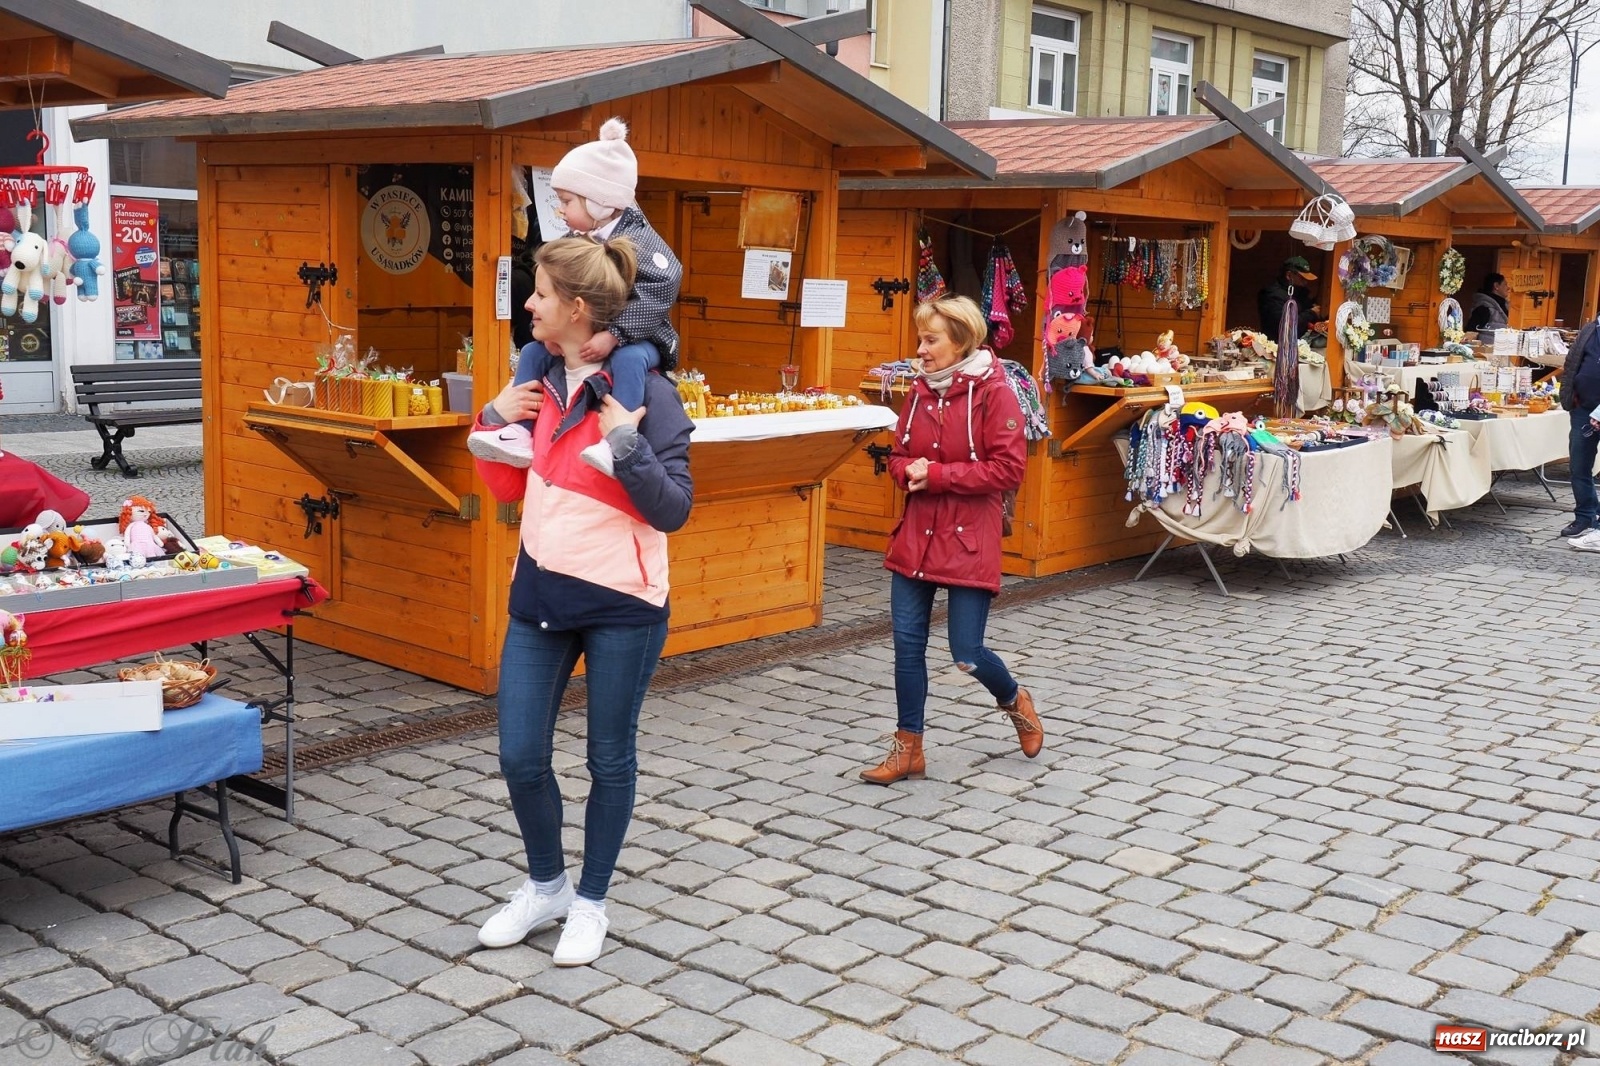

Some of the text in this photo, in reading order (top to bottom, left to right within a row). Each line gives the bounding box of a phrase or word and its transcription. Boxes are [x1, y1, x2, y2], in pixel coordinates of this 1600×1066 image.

[114, 202, 126, 210] gry
[380, 189, 423, 213] PASIECE
[114, 210, 149, 218] planszowe
[453, 209, 466, 218] 507
[118, 217, 147, 226] karciane
[453, 222, 473, 234] @wp
[115, 226, 153, 244] -20%
[377, 247, 424, 271] SĄSIADKÓW
